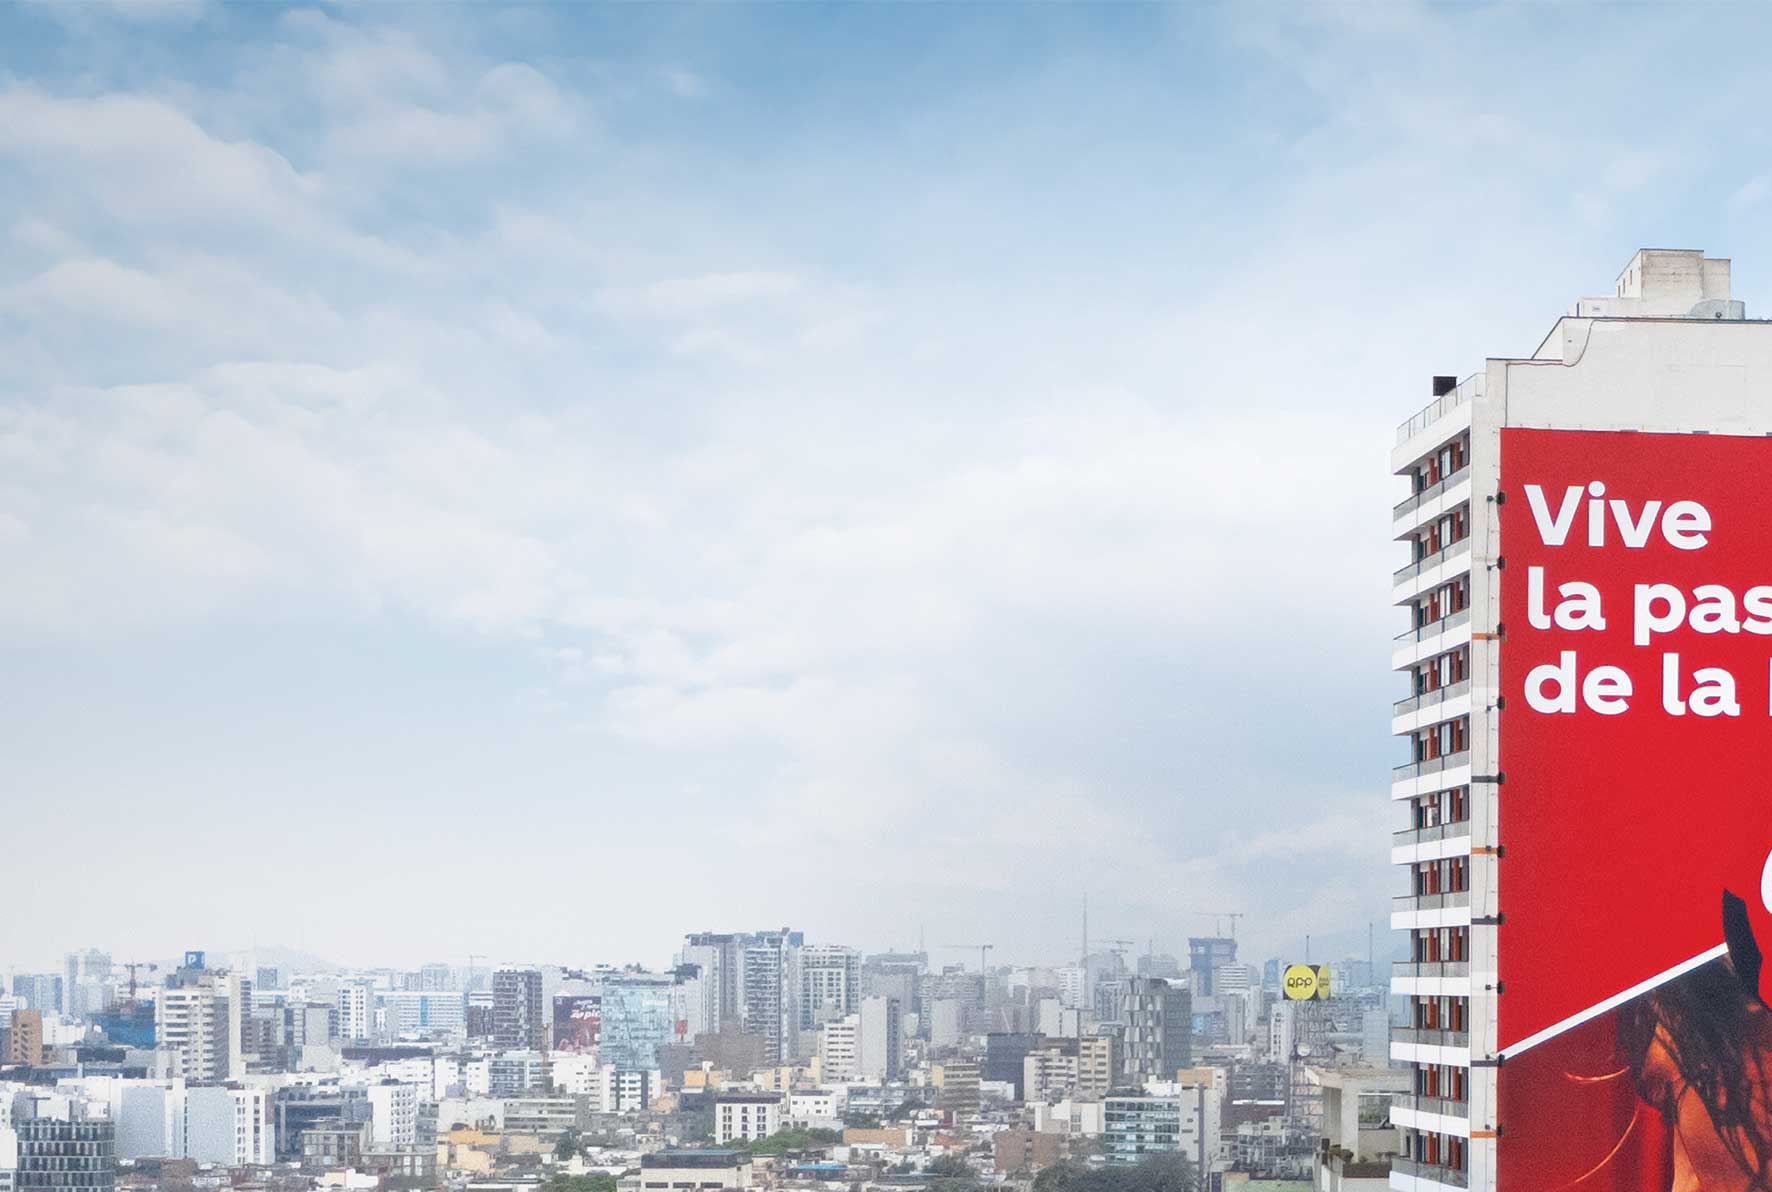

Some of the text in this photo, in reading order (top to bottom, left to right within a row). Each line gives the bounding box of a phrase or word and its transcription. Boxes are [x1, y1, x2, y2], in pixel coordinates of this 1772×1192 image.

[1523, 480, 1712, 550] Vive
[1527, 566, 1606, 631] la
[1524, 650, 1633, 715] de
[1662, 652, 1740, 716] la
